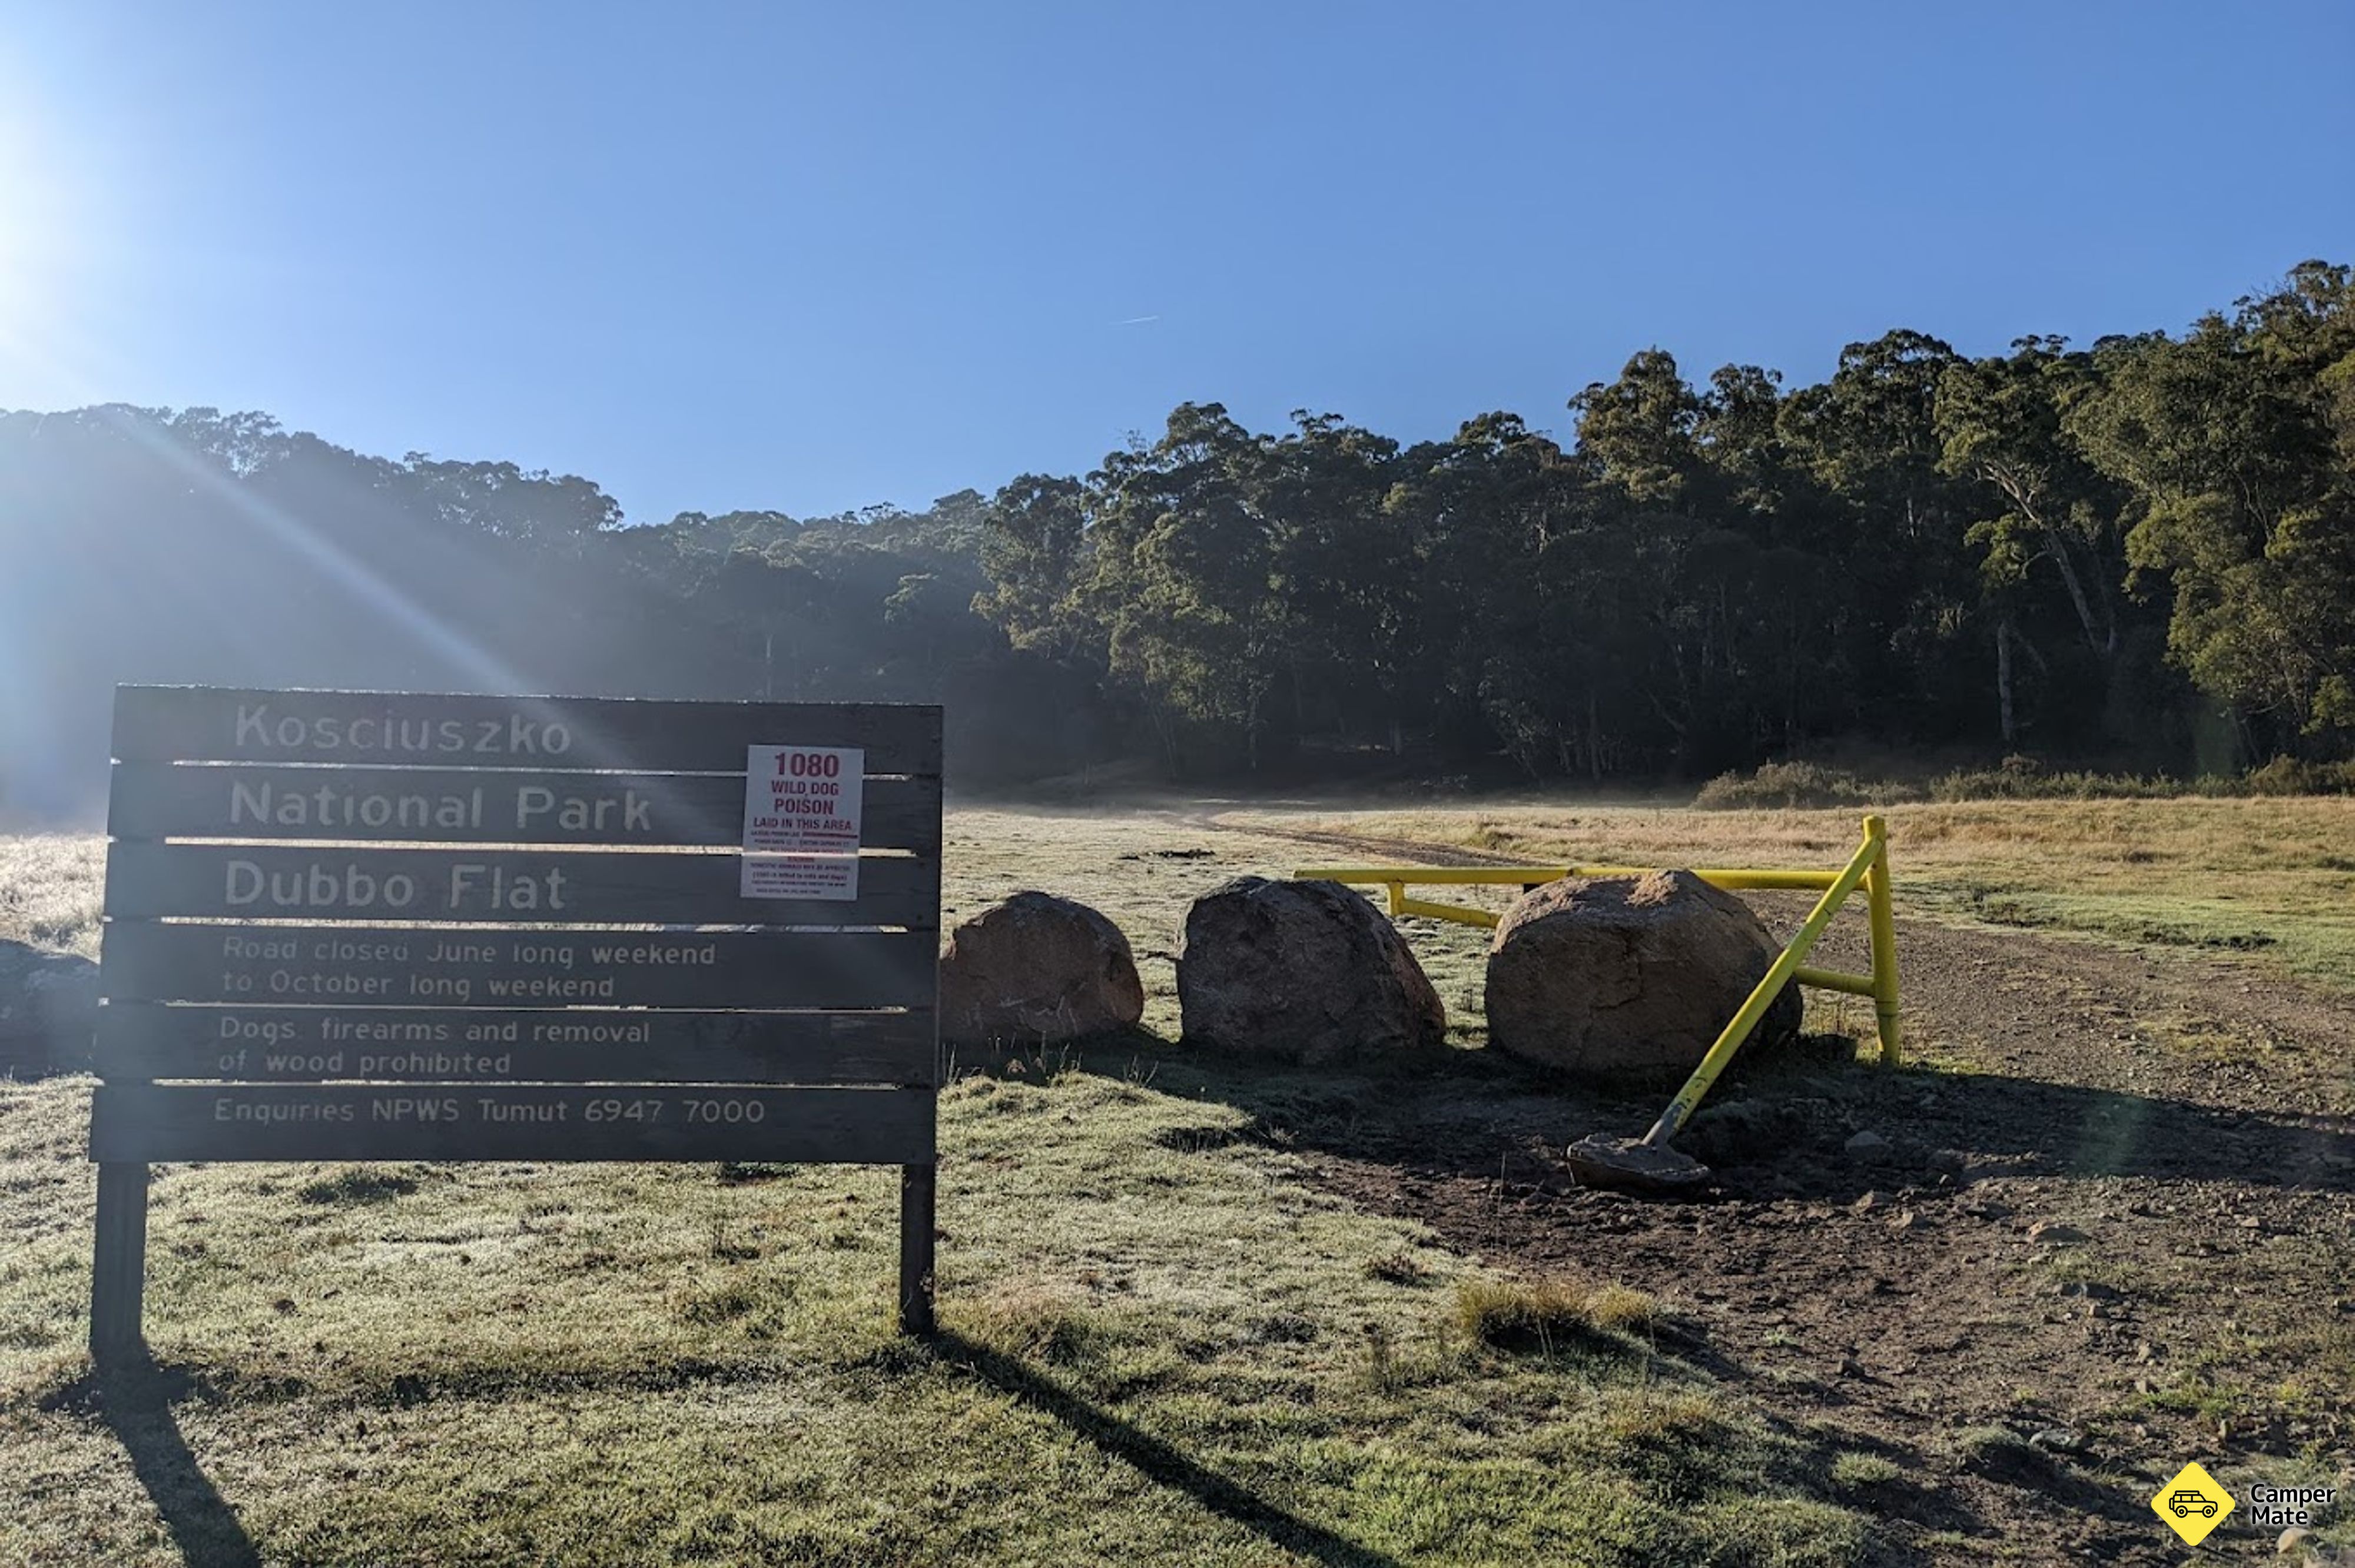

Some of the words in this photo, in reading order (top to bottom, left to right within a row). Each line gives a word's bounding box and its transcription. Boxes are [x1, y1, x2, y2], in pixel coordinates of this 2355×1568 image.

[236, 705, 571, 755] Kosciuszko
[774, 752, 840, 778] 1080
[771, 780, 806, 794] WILD
[811, 782, 839, 796] DOG
[230, 780, 482, 828] National
[517, 786, 652, 831] Park
[774, 799, 834, 814] POISON
[754, 817, 778, 828] LAID
[781, 818, 792, 828] IN
[797, 818, 820, 829] THIS
[823, 819, 852, 830] AREA
[225, 861, 414, 906] Dubbo
[449, 864, 568, 909] Flat
[223, 936, 297, 959] Road
[314, 941, 408, 960] closed
[427, 942, 496, 964] June
[513, 944, 574, 969] long
[592, 944, 715, 965] weekend
[223, 971, 252, 992] to
[270, 970, 393, 994] October
[410, 974, 470, 999] long
[488, 976, 613, 996] weekend
[322, 1017, 449, 1041] firearms
[466, 1021, 517, 1042] and
[533, 1022, 649, 1043] removal
[219, 1050, 247, 1072] of
[266, 1051, 343, 1074] wood
[360, 1052, 510, 1078] prohibited
[214, 1098, 354, 1125] Enquiries
[372, 1099, 459, 1121] NPWS
[479, 1099, 567, 1122] Tumut
[584, 1099, 664, 1122] 6947
[682, 1099, 765, 1123] 7000
